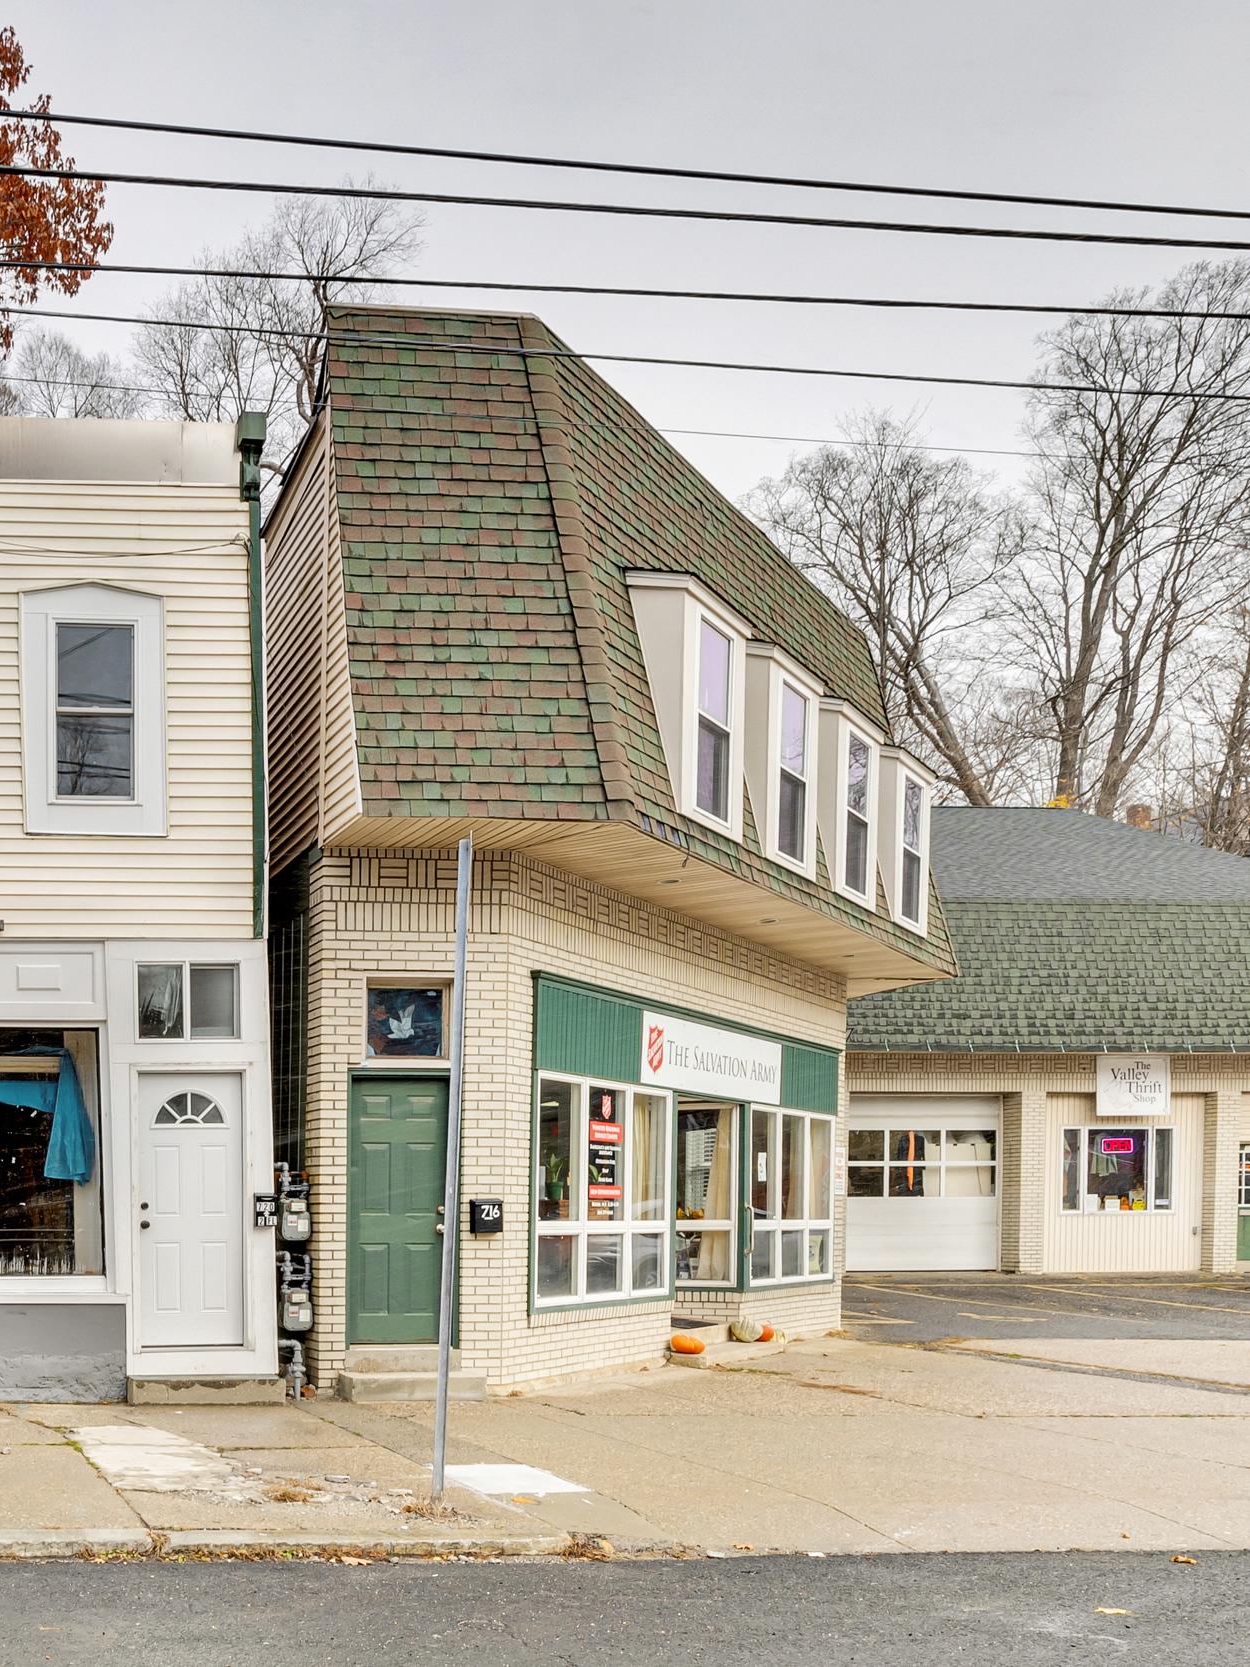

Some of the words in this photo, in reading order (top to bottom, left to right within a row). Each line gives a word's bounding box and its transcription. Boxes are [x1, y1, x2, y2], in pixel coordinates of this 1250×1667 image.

[667, 1040, 690, 1068] THE
[693, 1046, 747, 1079] SALVATION
[750, 1059, 778, 1085] ARMY
[1134, 1061, 1151, 1070] The
[1111, 1067, 1150, 1084] Valley
[1126, 1081, 1162, 1094] Thrift
[1134, 1094, 1156, 1105] Shop
[1104, 1140, 1132, 1151] OPEN
[257, 1202, 274, 1211] 720
[481, 1204, 500, 1219] 716
